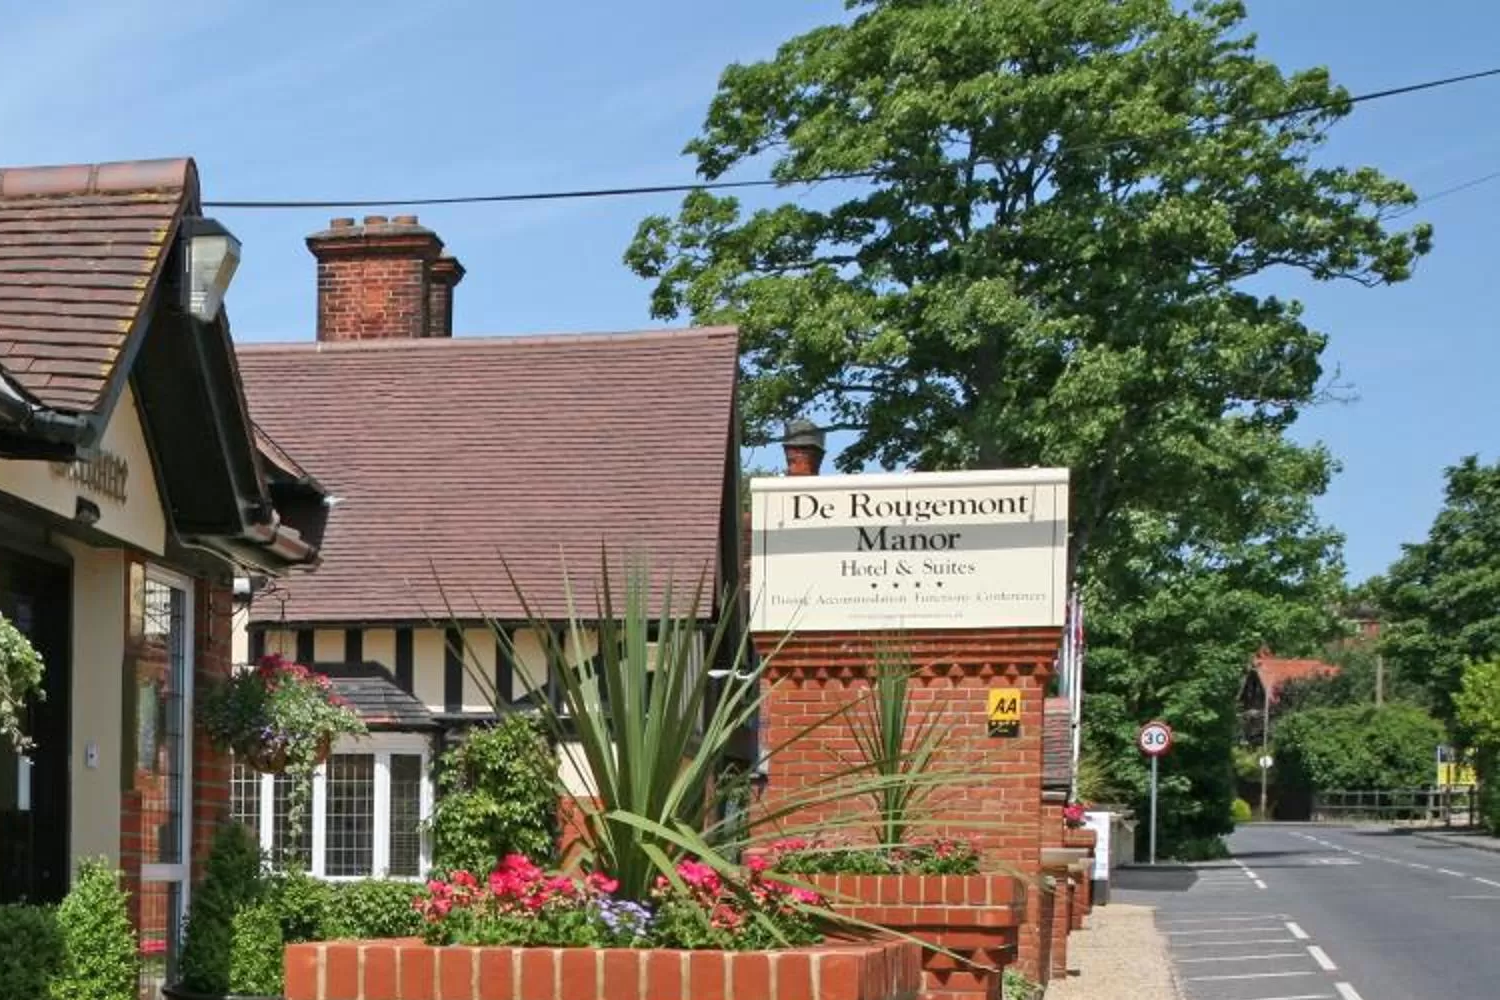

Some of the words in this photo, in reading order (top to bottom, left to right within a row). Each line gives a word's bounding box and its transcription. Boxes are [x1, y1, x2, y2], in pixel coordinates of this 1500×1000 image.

[792, 494, 835, 520] De
[850, 493, 1029, 521] Rougemont
[857, 526, 962, 552] Manor
[841, 559, 888, 577] Hotel
[895, 560, 913, 576] &
[923, 557, 977, 575] Suites
[993, 697, 1017, 714] AA
[1143, 731, 1166, 745] 30
